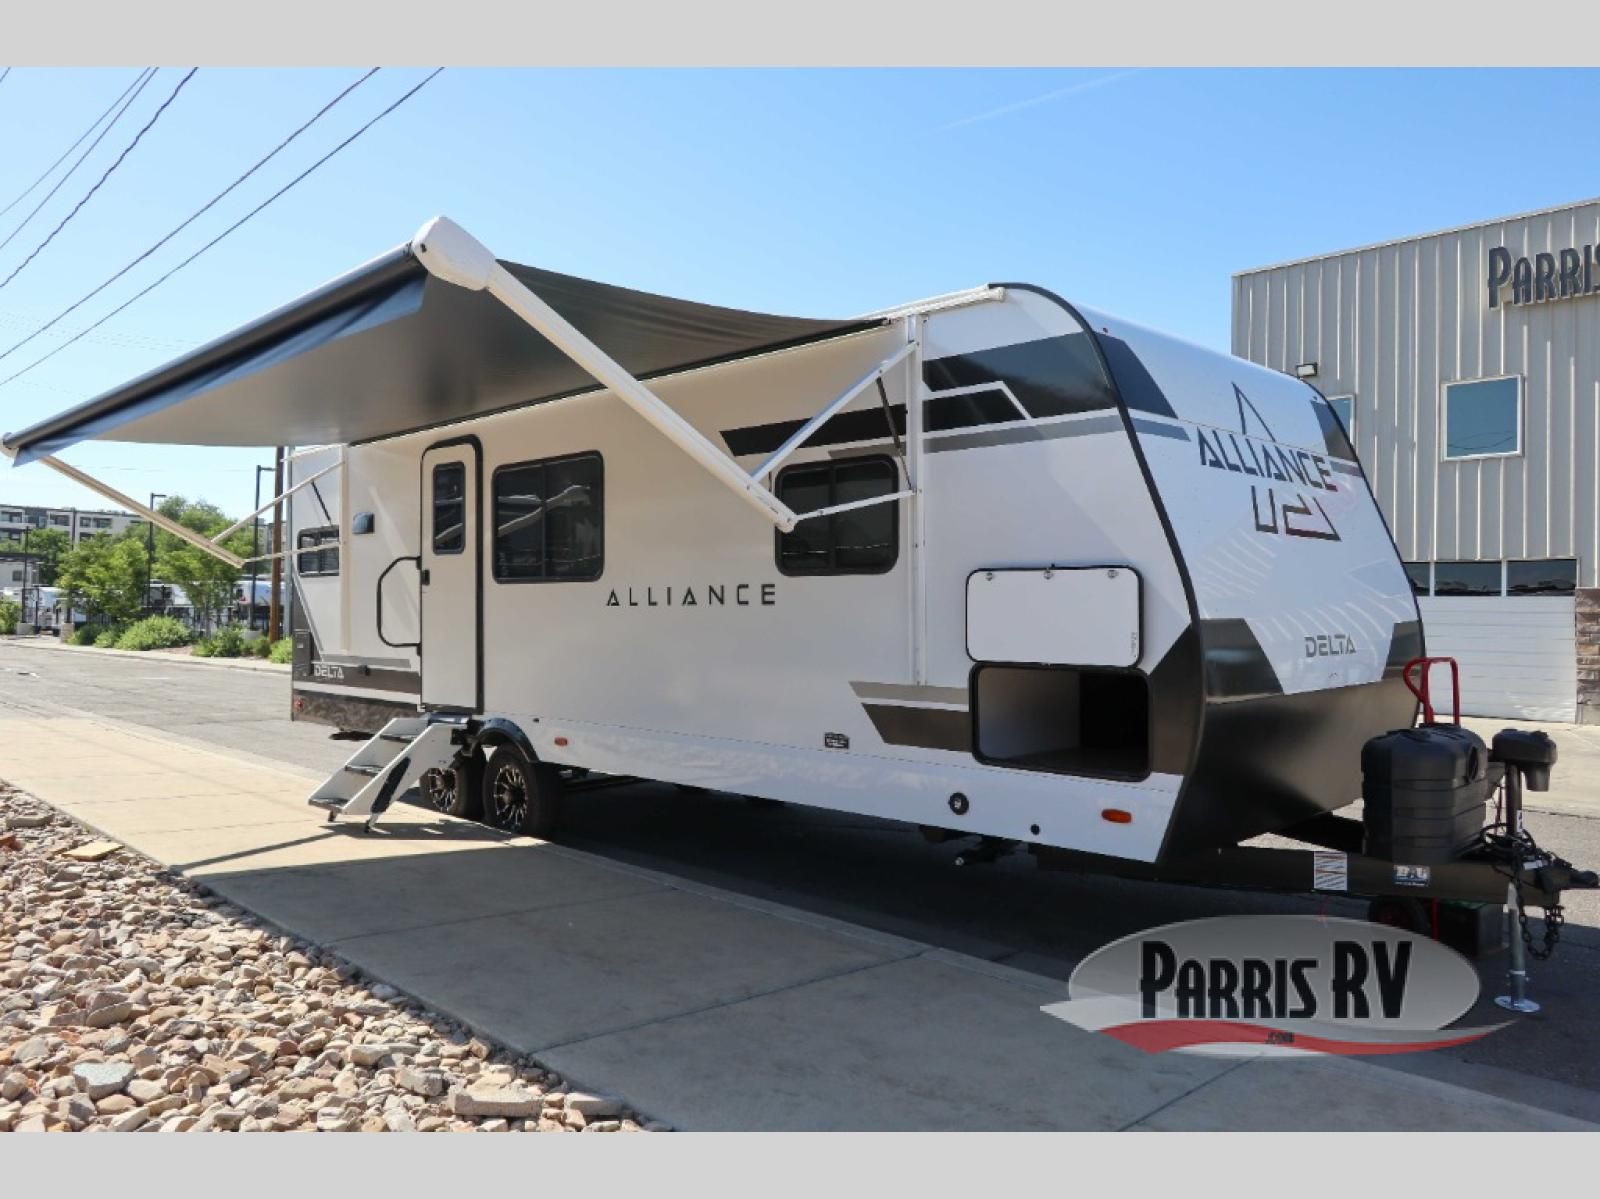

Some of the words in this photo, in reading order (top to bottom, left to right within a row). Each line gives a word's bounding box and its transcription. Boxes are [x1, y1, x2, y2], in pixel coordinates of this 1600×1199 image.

[1197, 427, 1338, 492] ALLIANCE
[606, 583, 776, 606] ALLIANCE
[1304, 632, 1357, 658] DELTA
[313, 664, 345, 679] DELTA
